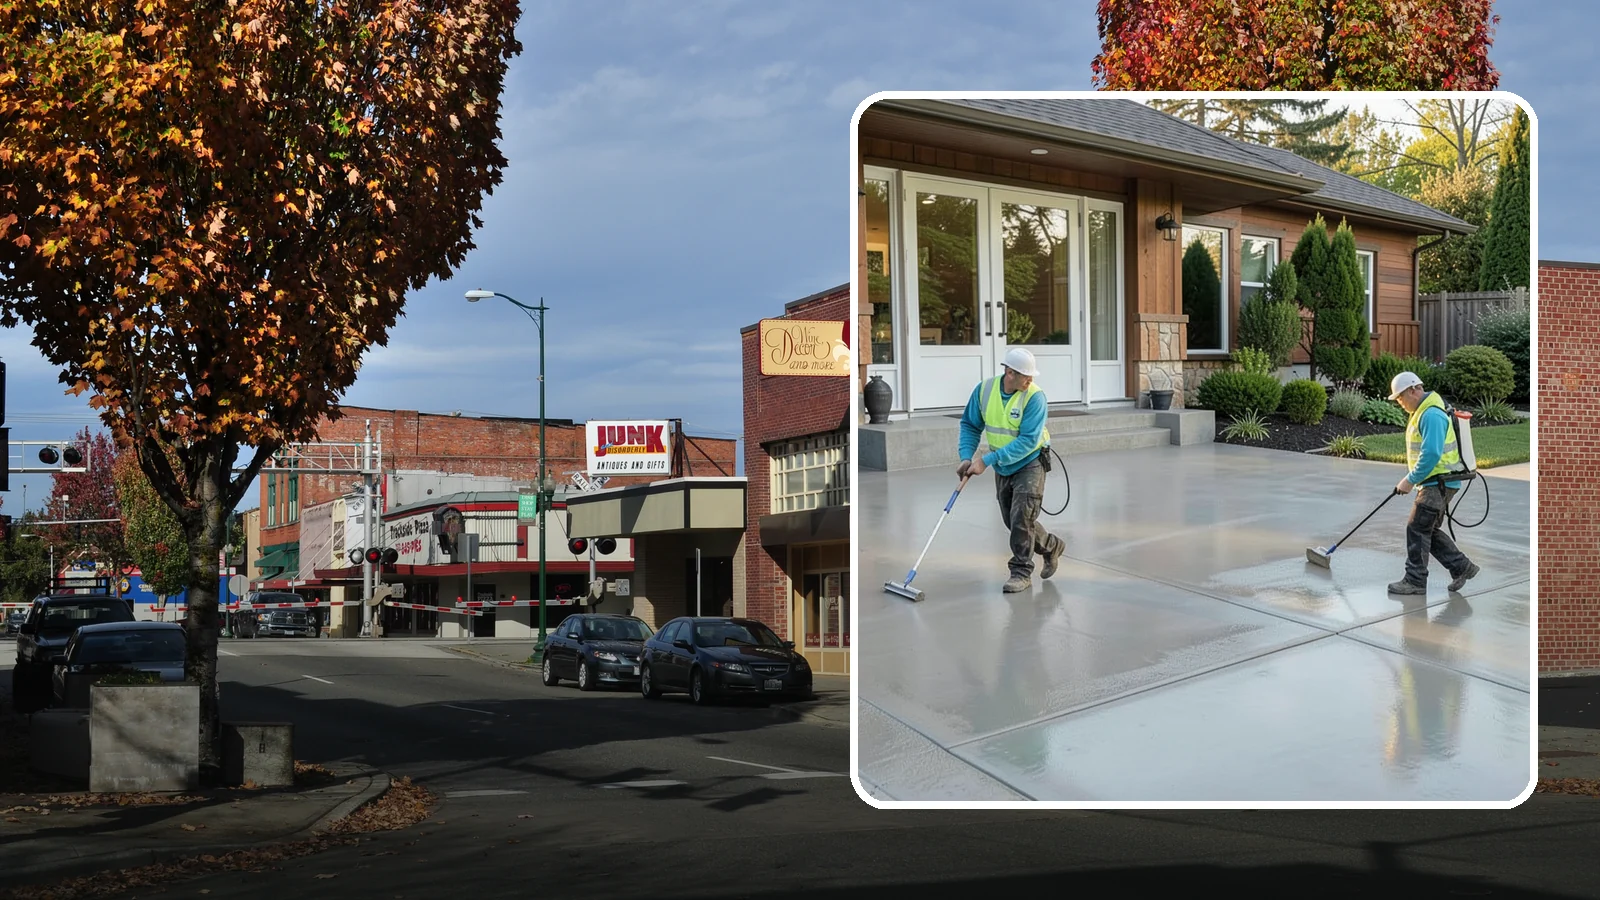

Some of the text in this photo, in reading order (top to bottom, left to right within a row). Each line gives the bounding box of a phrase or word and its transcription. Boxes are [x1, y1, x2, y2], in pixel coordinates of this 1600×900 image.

[595, 425, 665, 457] JUNK
[607, 446, 646, 454] DISORDERLY
[597, 460, 665, 470] ANTIQUES AND GIFTS
[390, 519, 429, 540] Trackside Pizza
